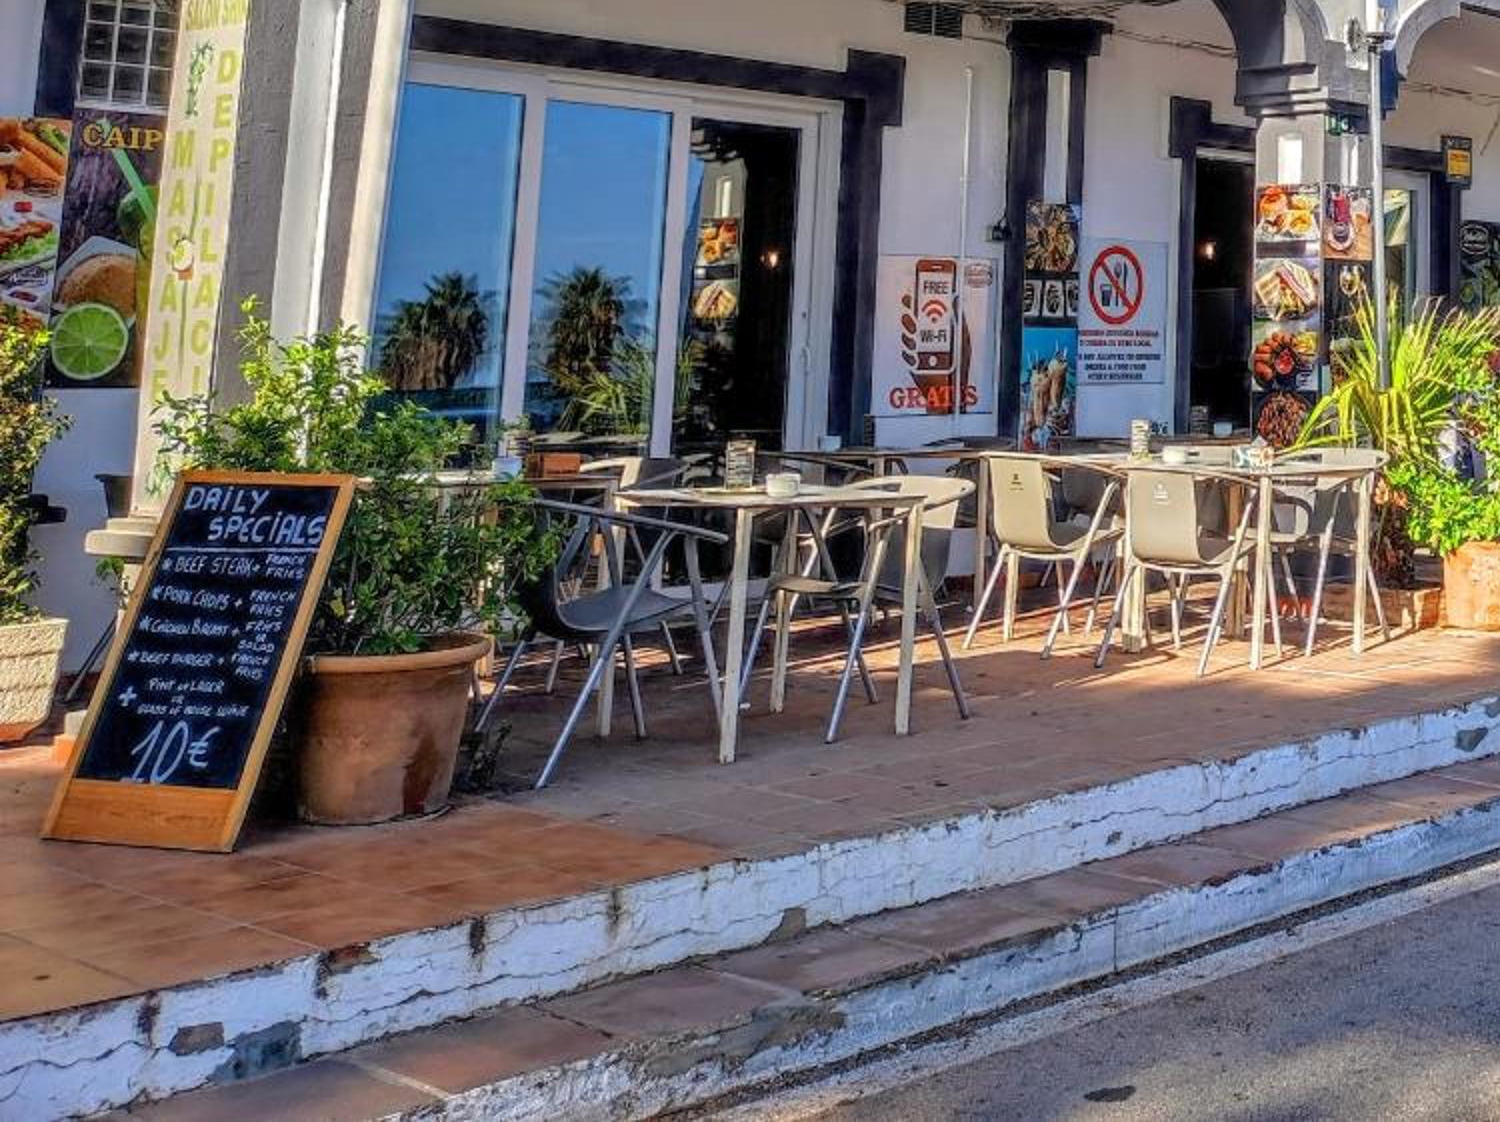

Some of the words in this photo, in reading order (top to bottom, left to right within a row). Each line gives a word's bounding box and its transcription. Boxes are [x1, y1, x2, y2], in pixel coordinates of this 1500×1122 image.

[922, 280, 949, 295] FREE
[175, 555, 208, 574] BEEF
[209, 557, 253, 577] STEAK
[265, 553, 307, 566] FRENCH
[163, 585, 193, 605] PORK
[192, 589, 230, 611] CHOPS
[250, 589, 297, 602] FRENCH
[249, 603, 285, 617] FRIES
[245, 620, 283, 633] FRIES
[139, 651, 170, 665] BEEF
[171, 653, 215, 667] BURGER
[149, 678, 176, 692] PINT
[130, 718, 223, 785] 10€
